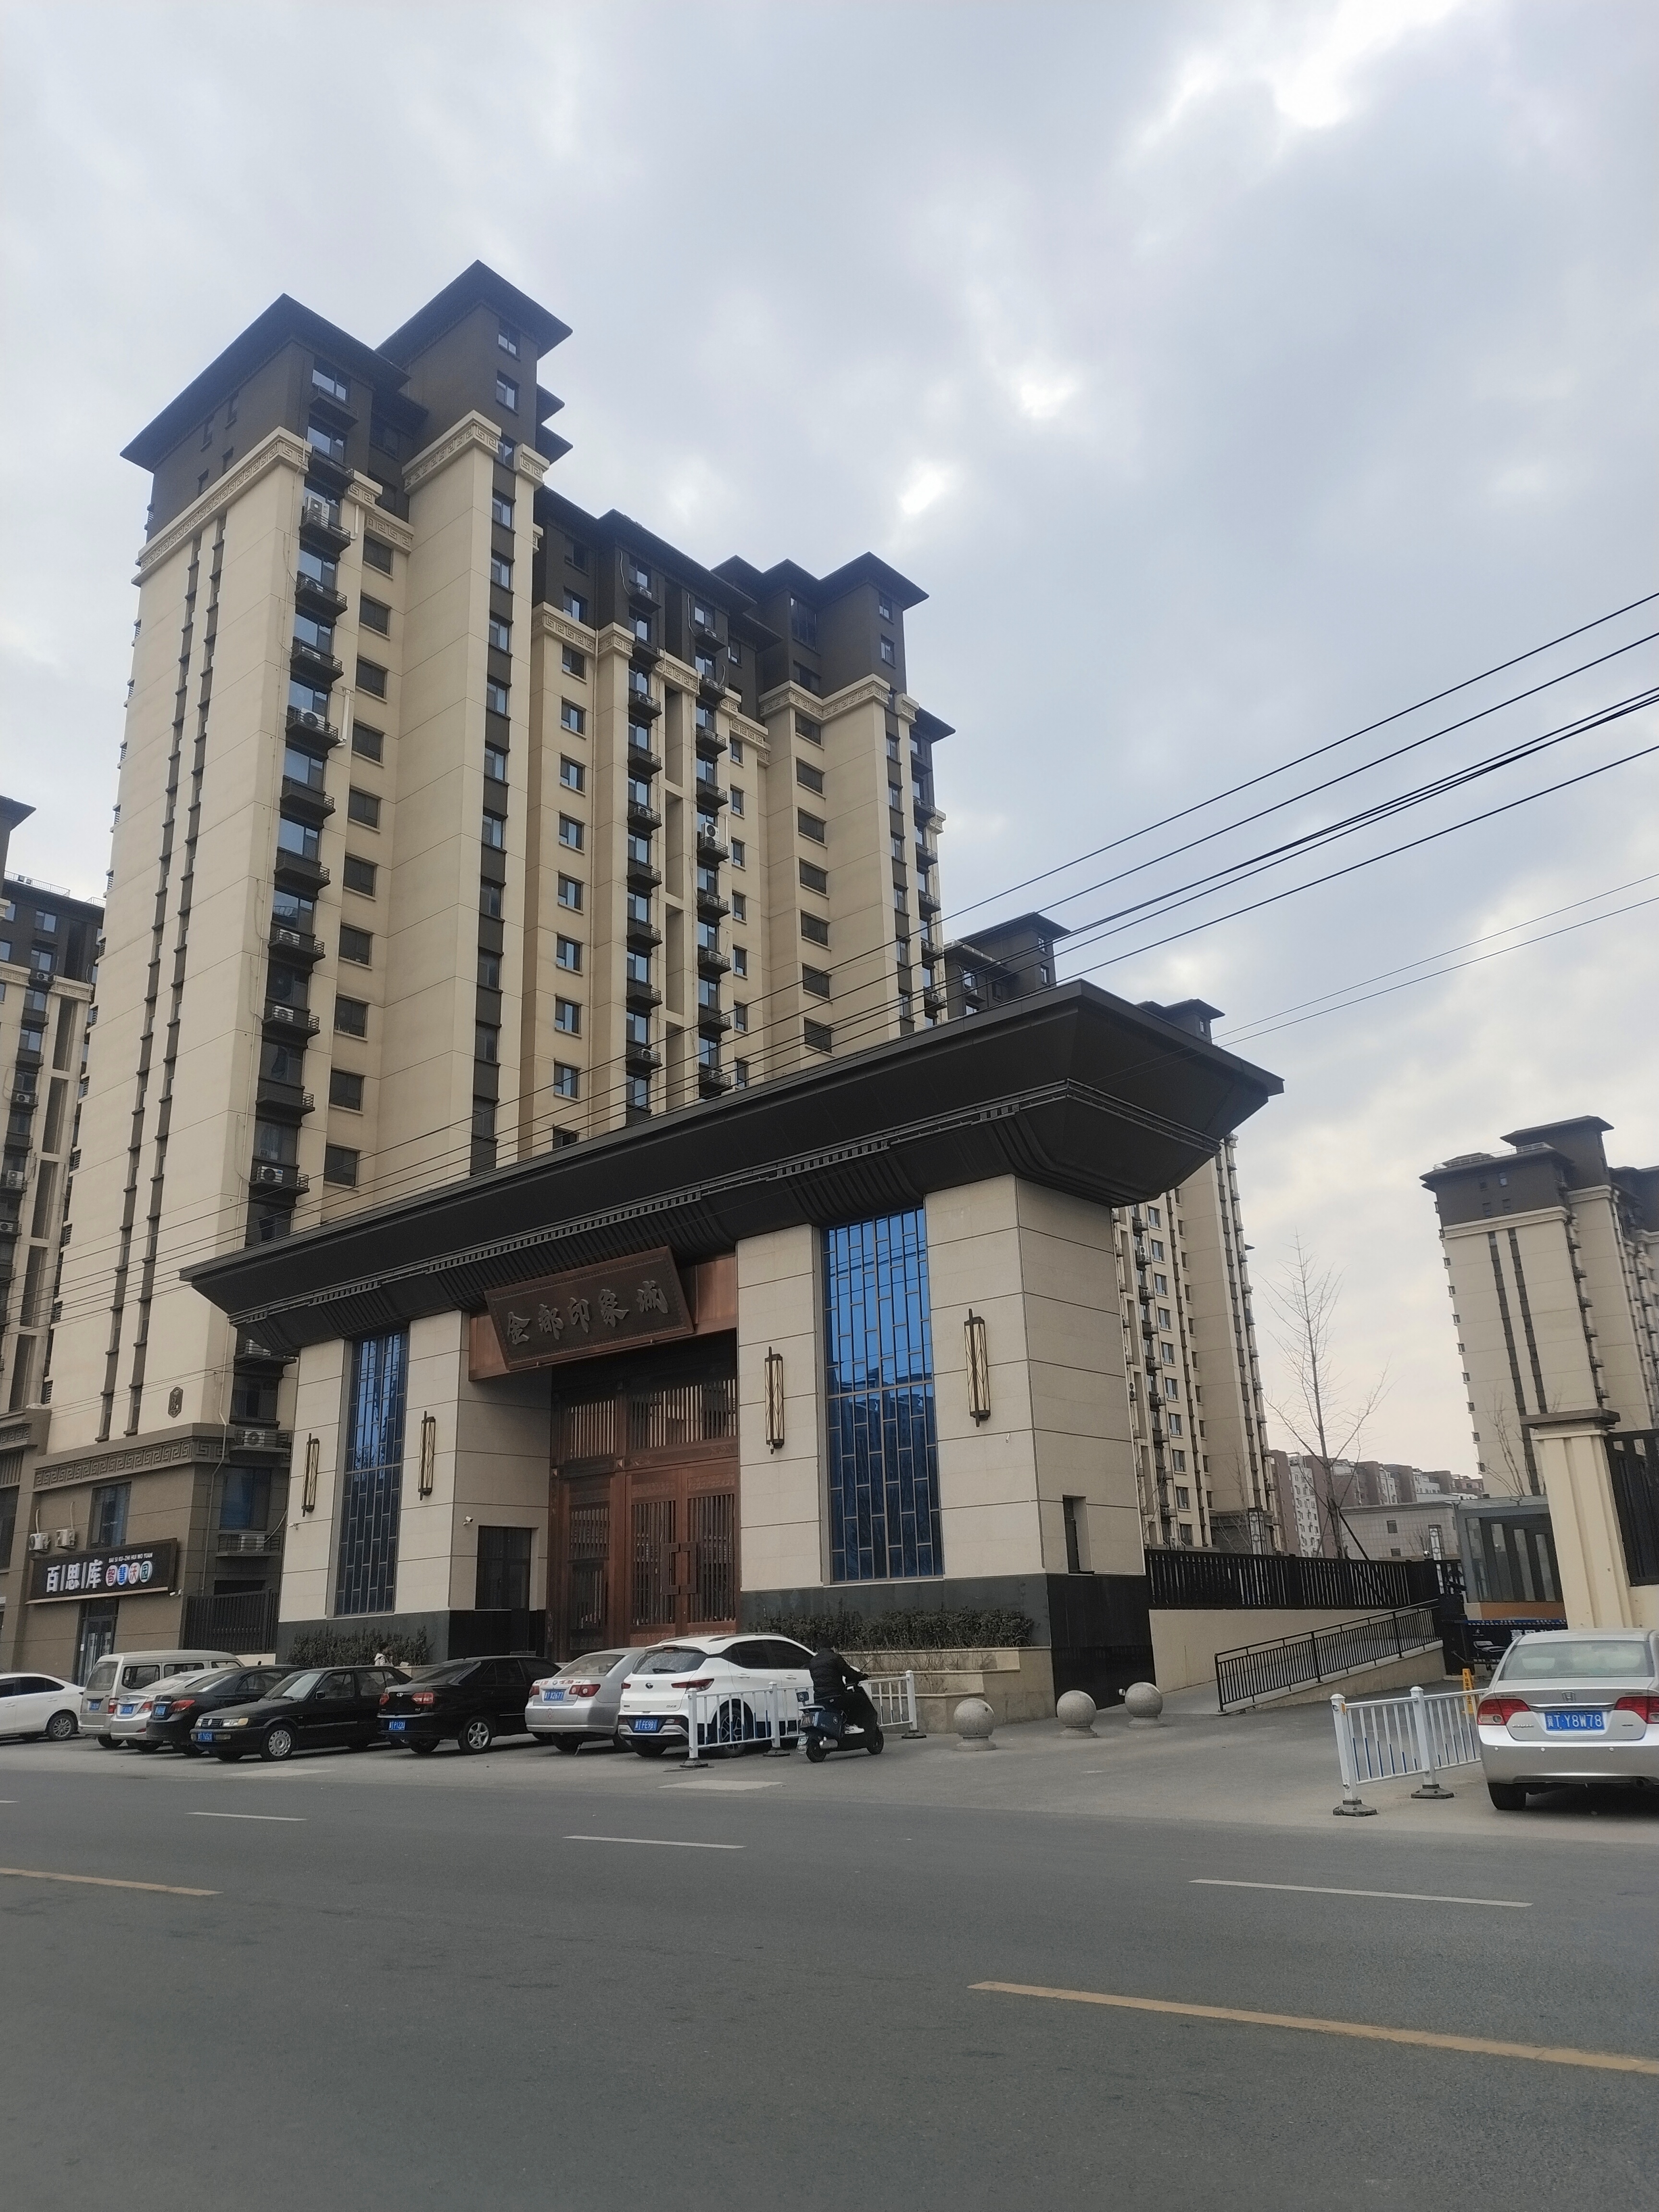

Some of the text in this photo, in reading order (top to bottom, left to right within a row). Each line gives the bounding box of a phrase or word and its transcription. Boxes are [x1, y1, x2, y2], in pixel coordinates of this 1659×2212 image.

[507, 1280, 669, 1345] 金都印象城
[106, 1563, 150, 1585] 智慧沃园
